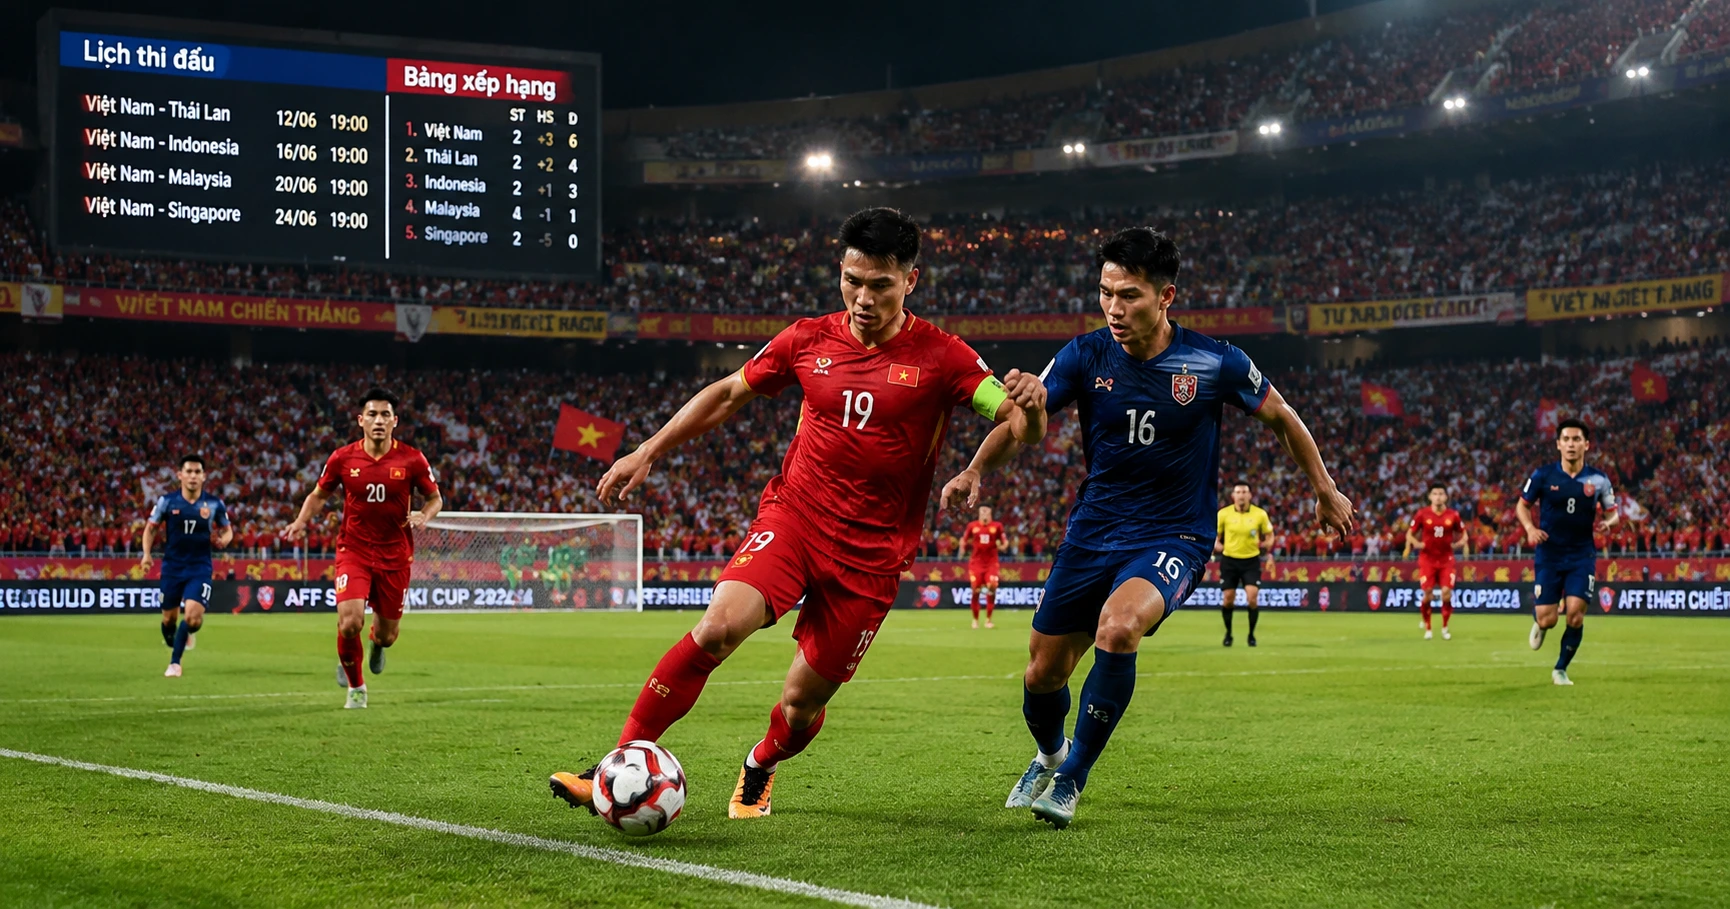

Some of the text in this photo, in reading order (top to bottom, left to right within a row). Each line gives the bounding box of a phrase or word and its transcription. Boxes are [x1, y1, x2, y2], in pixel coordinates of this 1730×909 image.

[84, 39, 215, 72] Lịch thi đấu
[462, 69, 501, 97] xếp
[505, 73, 556, 102] hạng
[85, 95, 117, 117] Việt
[120, 97, 155, 116] Nam
[167, 100, 201, 120] Thái
[204, 103, 231, 122] Lan
[276, 109, 317, 129] 12/06
[329, 113, 369, 133] 19:00
[509, 107, 527, 122] ST
[536, 109, 555, 124] HS
[85, 128, 117, 150] Việt
[120, 130, 155, 149] Nam
[168, 134, 240, 156] Indonesia
[276, 142, 318, 162] 16/06
[329, 146, 369, 165] 19:00
[405, 121, 579, 149] 1. Việt Nam 2 +3 6
[404, 147, 579, 174] 2. Thái Lan 2 +2 4
[85, 162, 117, 184] Việt
[120, 164, 155, 183] Nam
[168, 167, 232, 191] Malaysia
[275, 175, 318, 194] 20/06
[329, 178, 369, 197] 19:00
[405, 173, 579, 200] 3. Indonesia 2 +1 3
[85, 196, 117, 218] Việt
[120, 198, 155, 217] Nam
[167, 200, 241, 225] Singapore
[275, 208, 318, 227] 24/06
[329, 211, 369, 230] 19:00
[404, 199, 578, 224] 4. Malaysia 4 -1 1
[404, 225, 579, 250] 5. Singapore 2 -5 0
[178, 299, 224, 317] NAM
[842, 390, 874, 430] 19
[1126, 408, 1156, 446] 16
[366, 483, 386, 503] 20
[1566, 497, 1576, 514] 8
[184, 519, 197, 535] 17
[739, 530, 775, 554] 19
[1151, 551, 1185, 580] 16
[284, 588, 323, 607] AFF
[431, 588, 470, 606] CUP
[1385, 588, 1413, 607] AFF
[1618, 589, 1645, 610] AFF
[852, 629, 874, 657] 19
